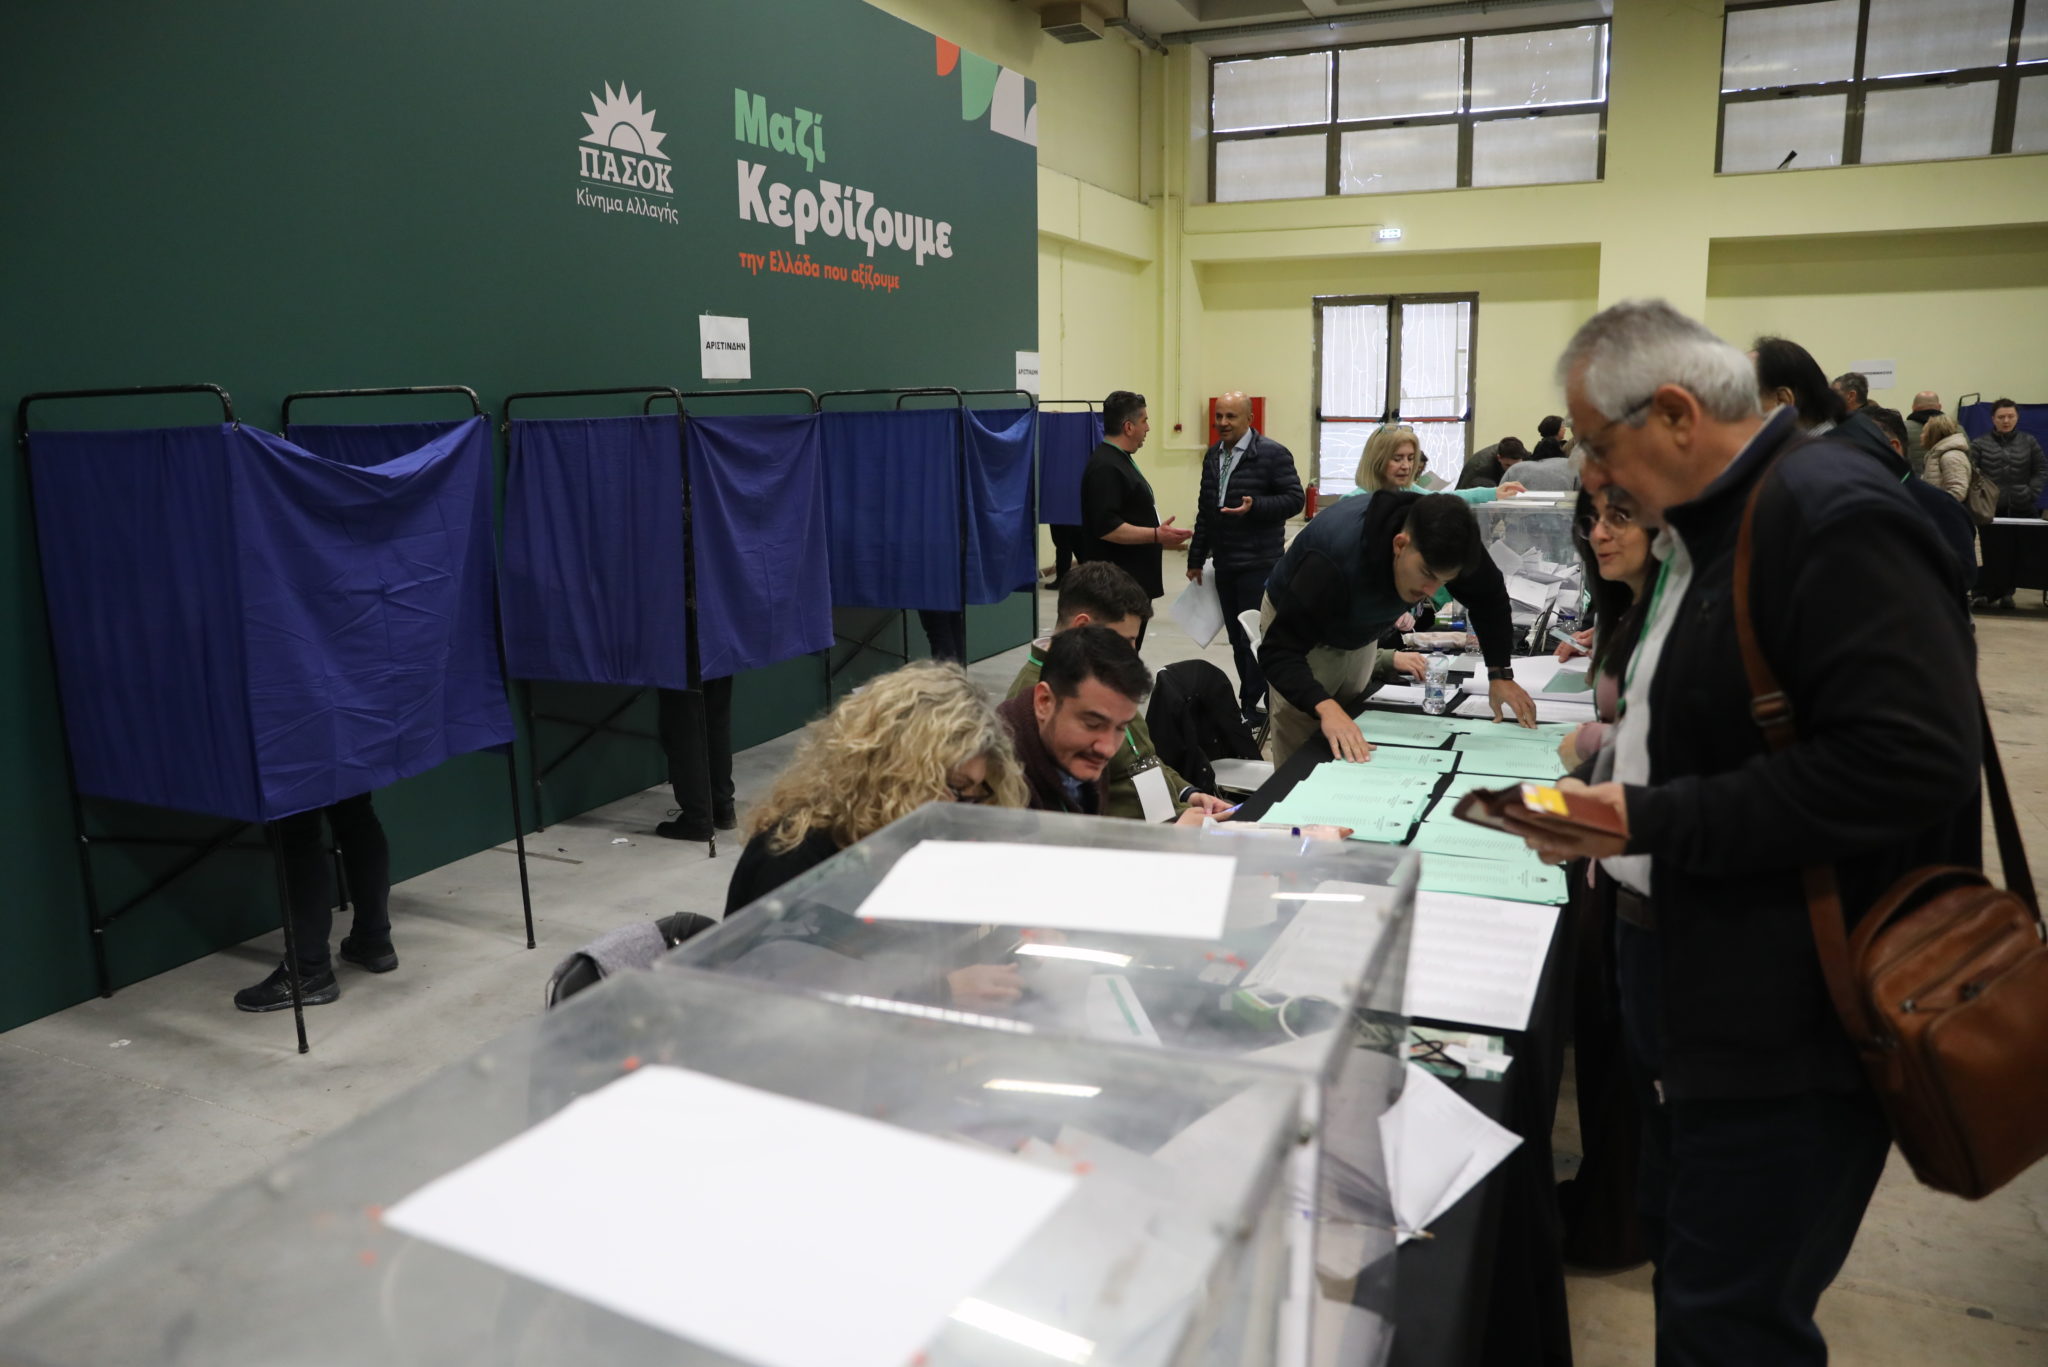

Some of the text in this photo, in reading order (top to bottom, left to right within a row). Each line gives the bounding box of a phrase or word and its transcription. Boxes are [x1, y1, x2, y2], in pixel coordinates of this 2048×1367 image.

[735, 88, 826, 173] Μαζί
[578, 145, 674, 194] ΠΑΣΟΚ
[576, 187, 679, 225] Κίνημα Αλλαγής
[737, 159, 953, 266] Κερδίζουμε
[738, 250, 900, 293] την Ελλάδα που αξίζουμε
[705, 341, 746, 351] ΑΡΙΣΤΙΝΔΗΝ
